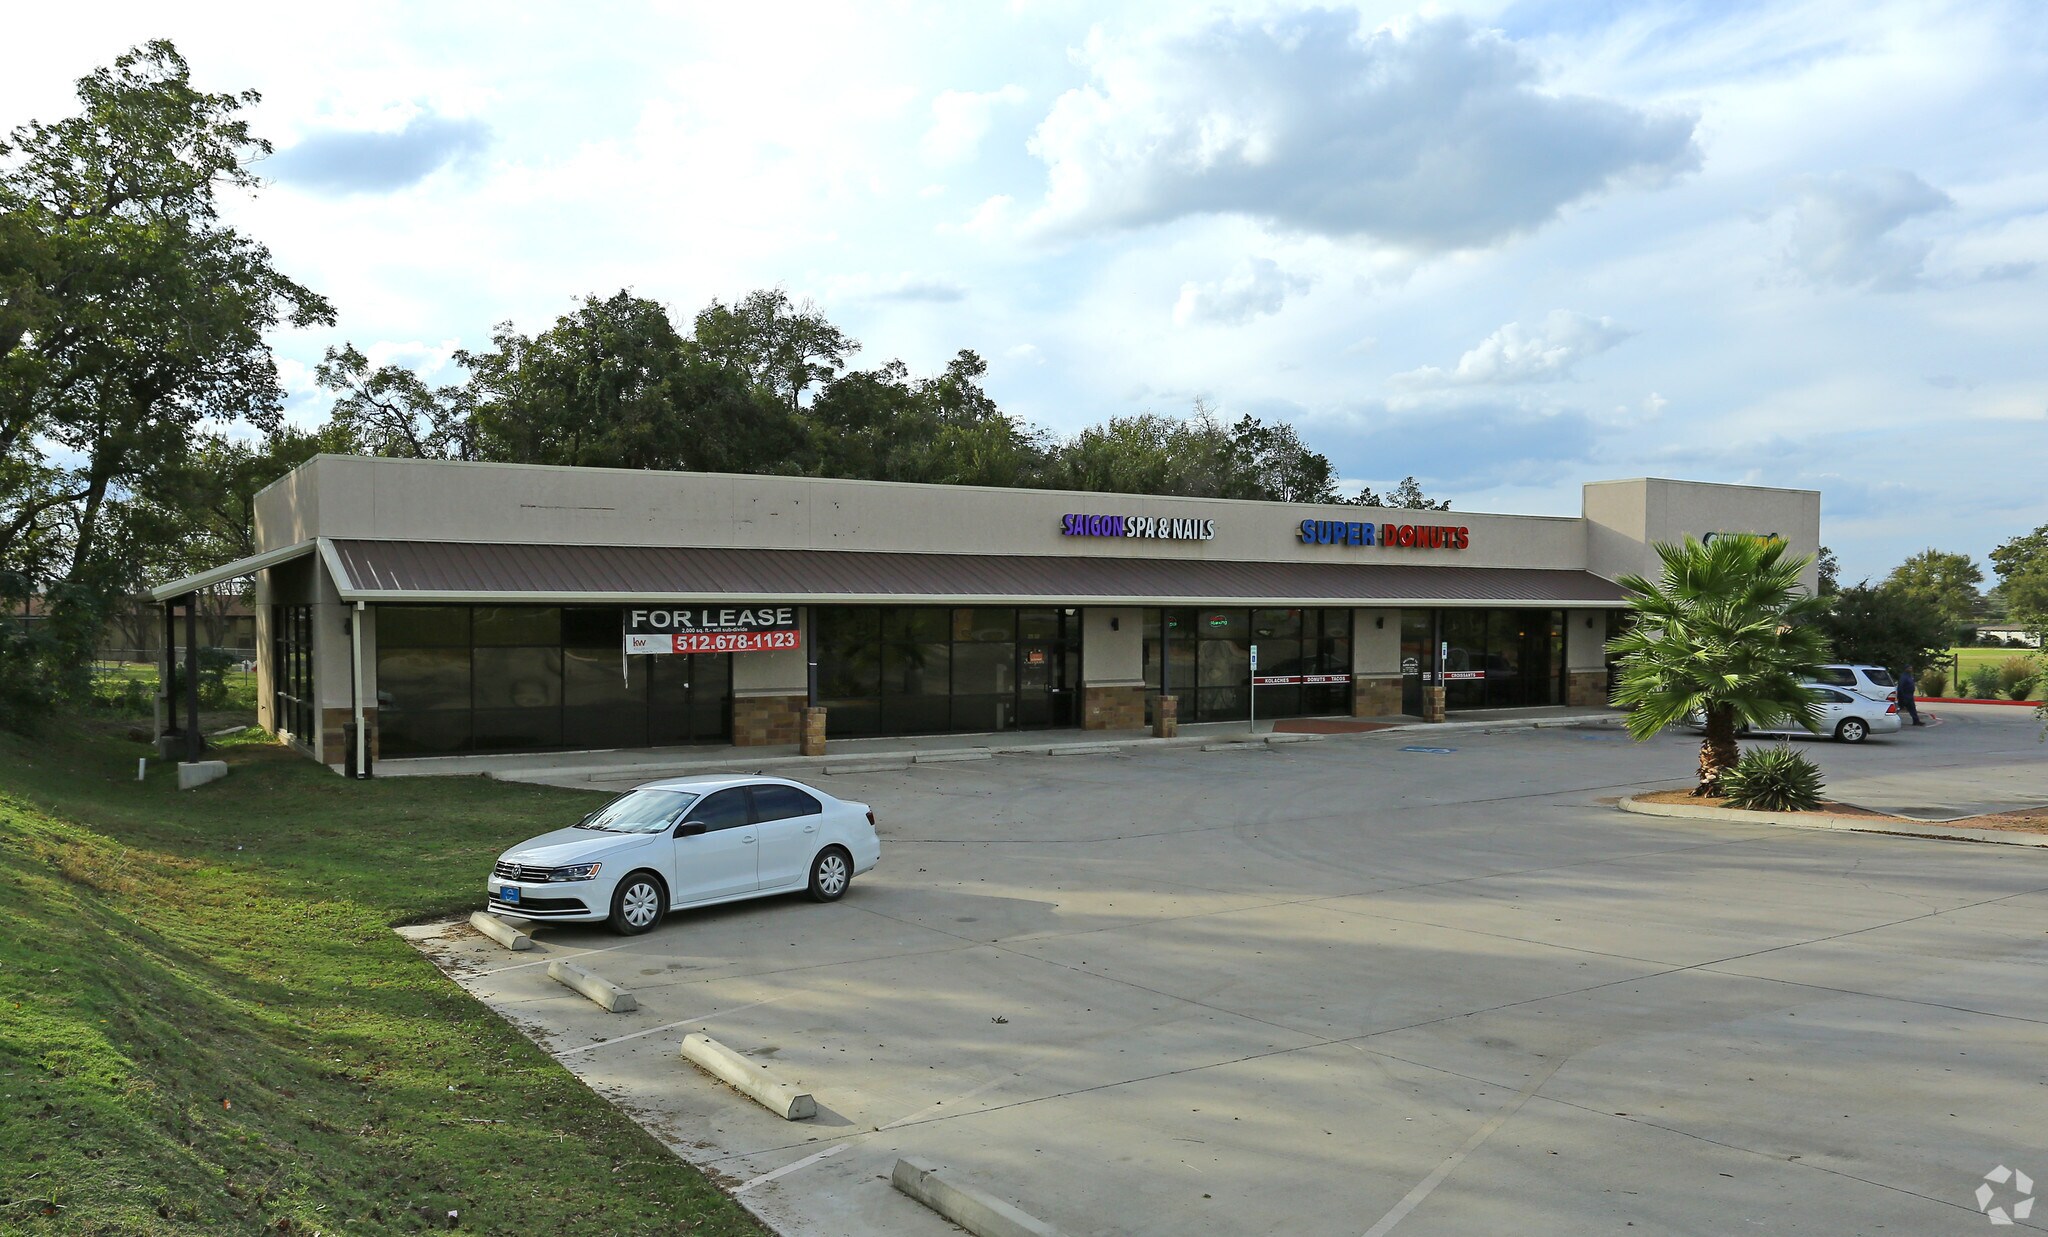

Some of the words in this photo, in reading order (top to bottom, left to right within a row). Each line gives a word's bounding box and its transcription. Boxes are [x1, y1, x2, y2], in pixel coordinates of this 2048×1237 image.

[1063, 514, 1123, 537] SAIGON
[1126, 516, 1154, 538] SPA
[1158, 517, 1170, 539] &
[1172, 518, 1215, 540] NAILS
[1301, 519, 1376, 546] SUPER
[1382, 523, 1469, 549] DONUTS
[632, 610, 693, 628] FOR
[702, 608, 793, 626] LEASE
[677, 632, 795, 650] 512.678-1123
